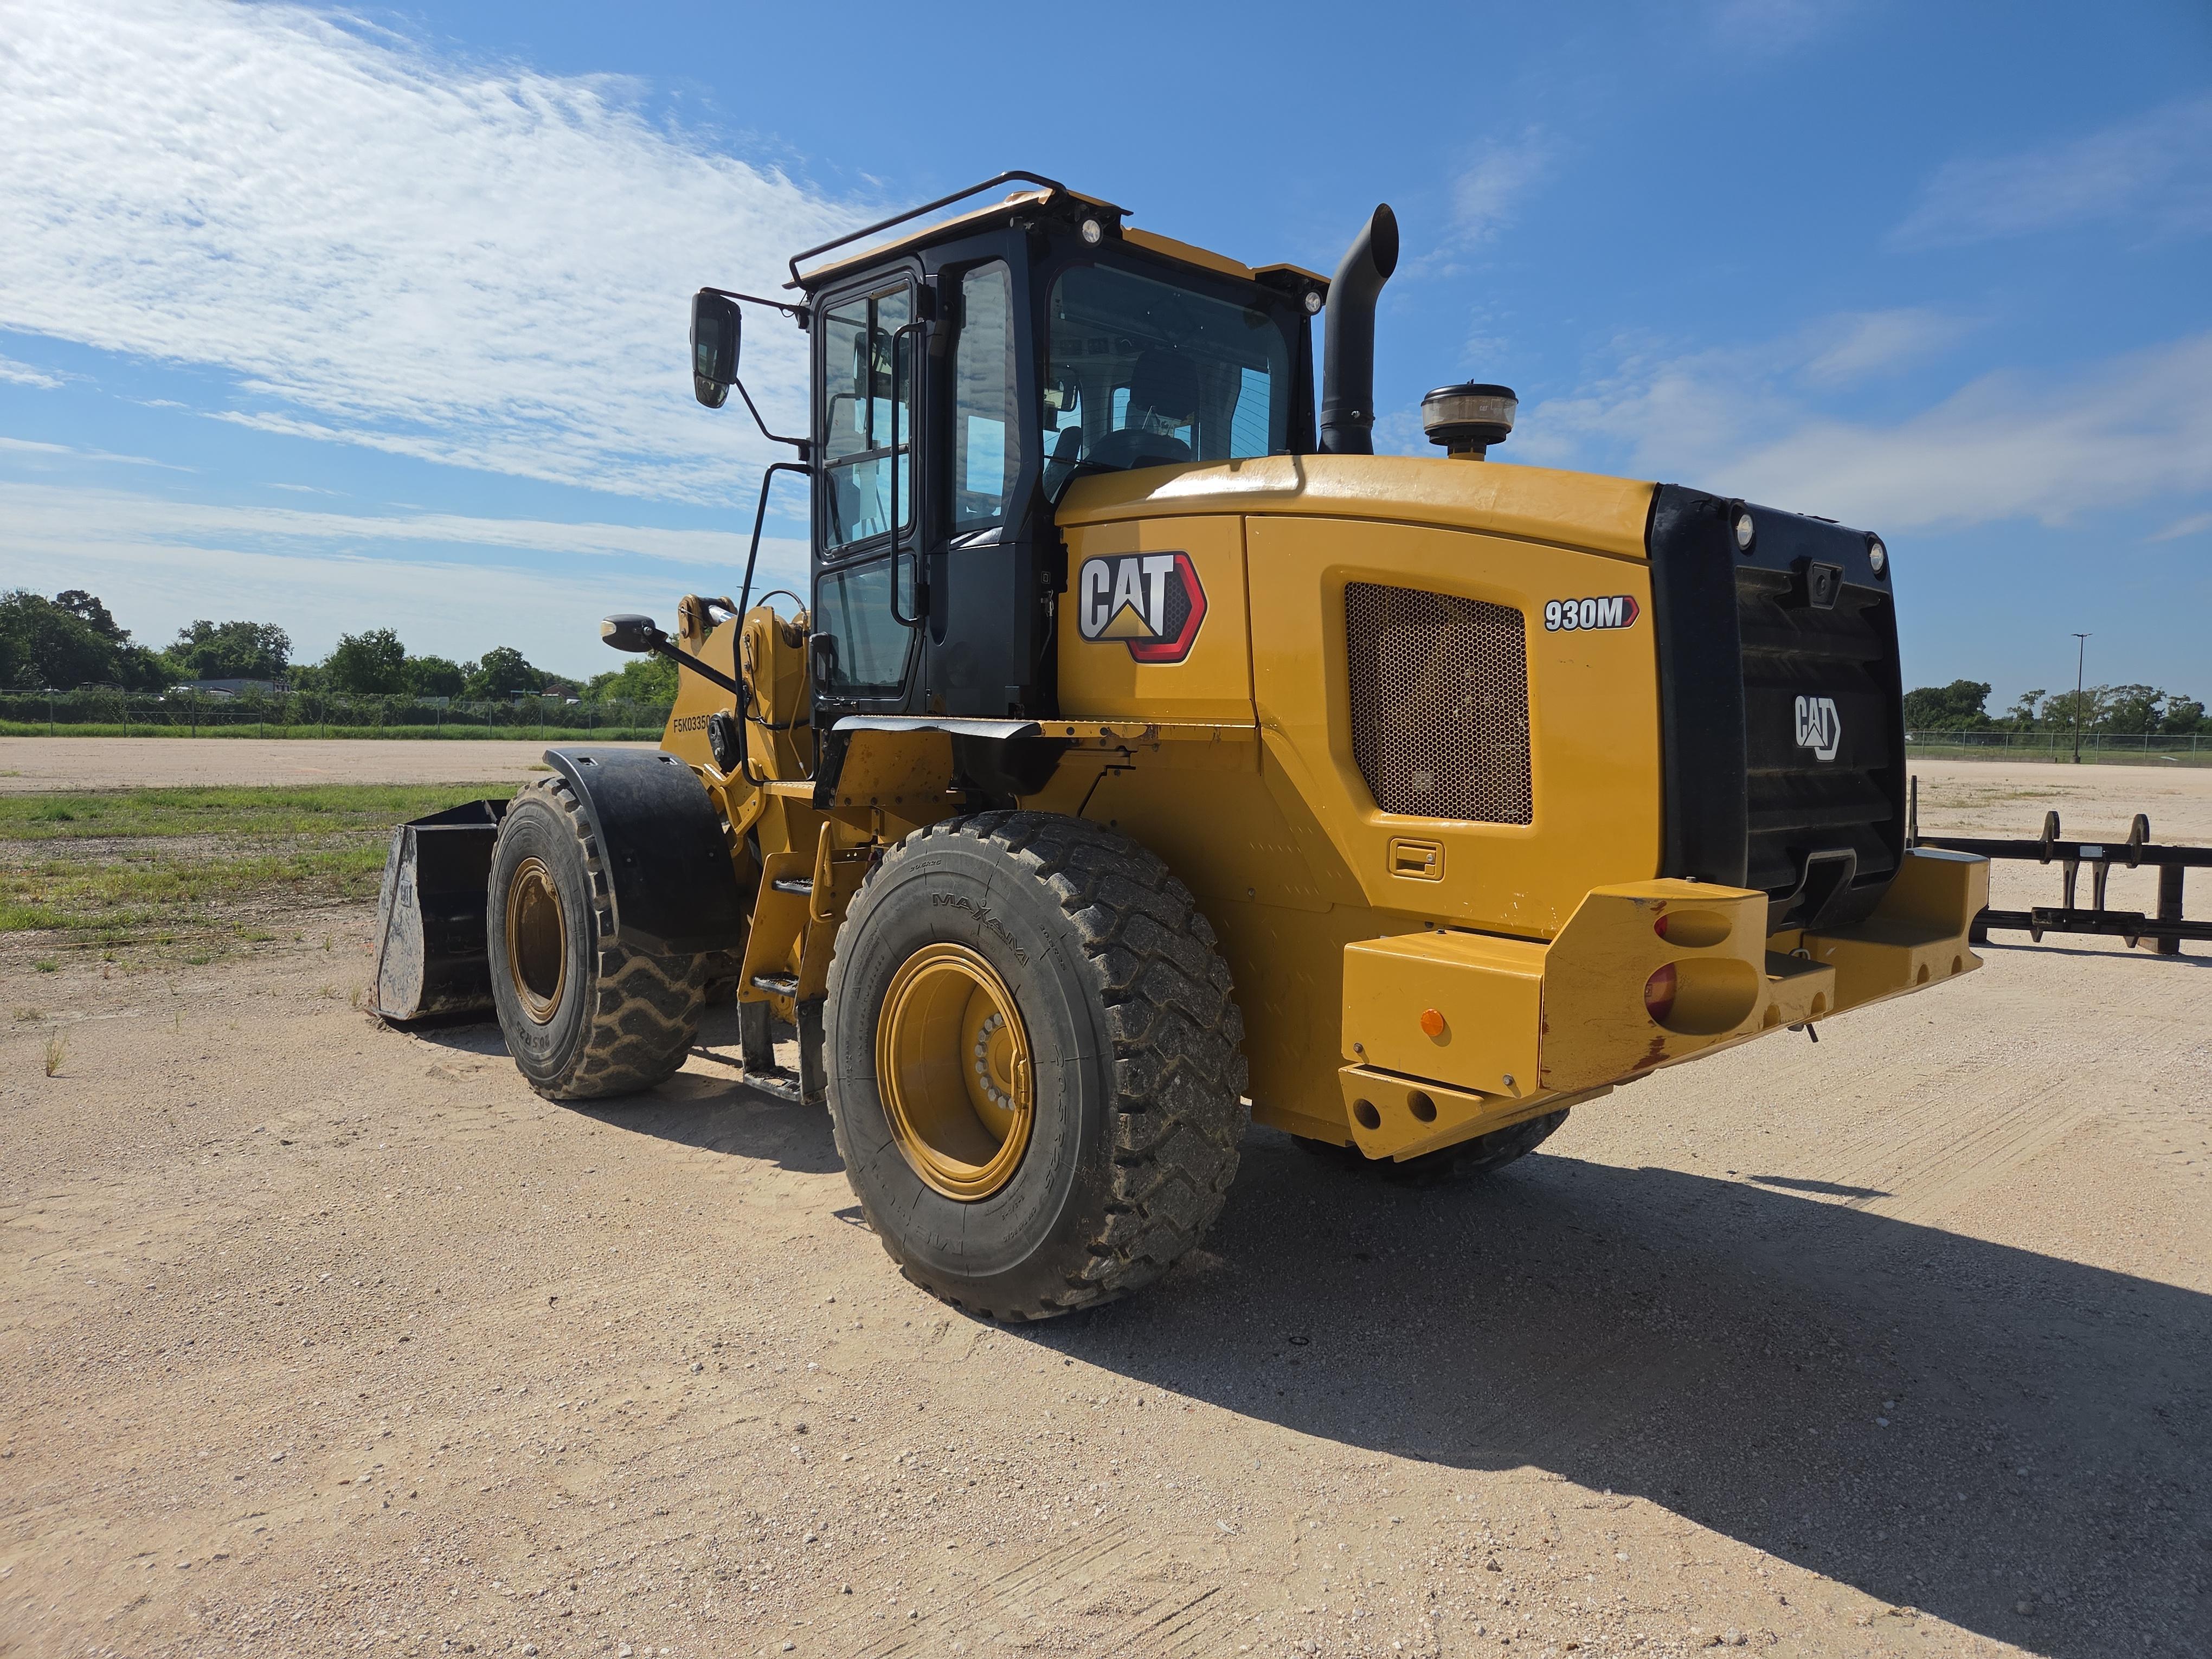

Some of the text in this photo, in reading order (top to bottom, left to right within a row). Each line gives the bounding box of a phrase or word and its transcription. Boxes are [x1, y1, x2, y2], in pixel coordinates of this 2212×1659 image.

[1081, 555, 1174, 638] CAT
[1546, 597, 1623, 630] 930M
[674, 715, 710, 733] F5K03350
[1795, 696, 1830, 747] CAT
[933, 892, 1030, 968] MAXAM
